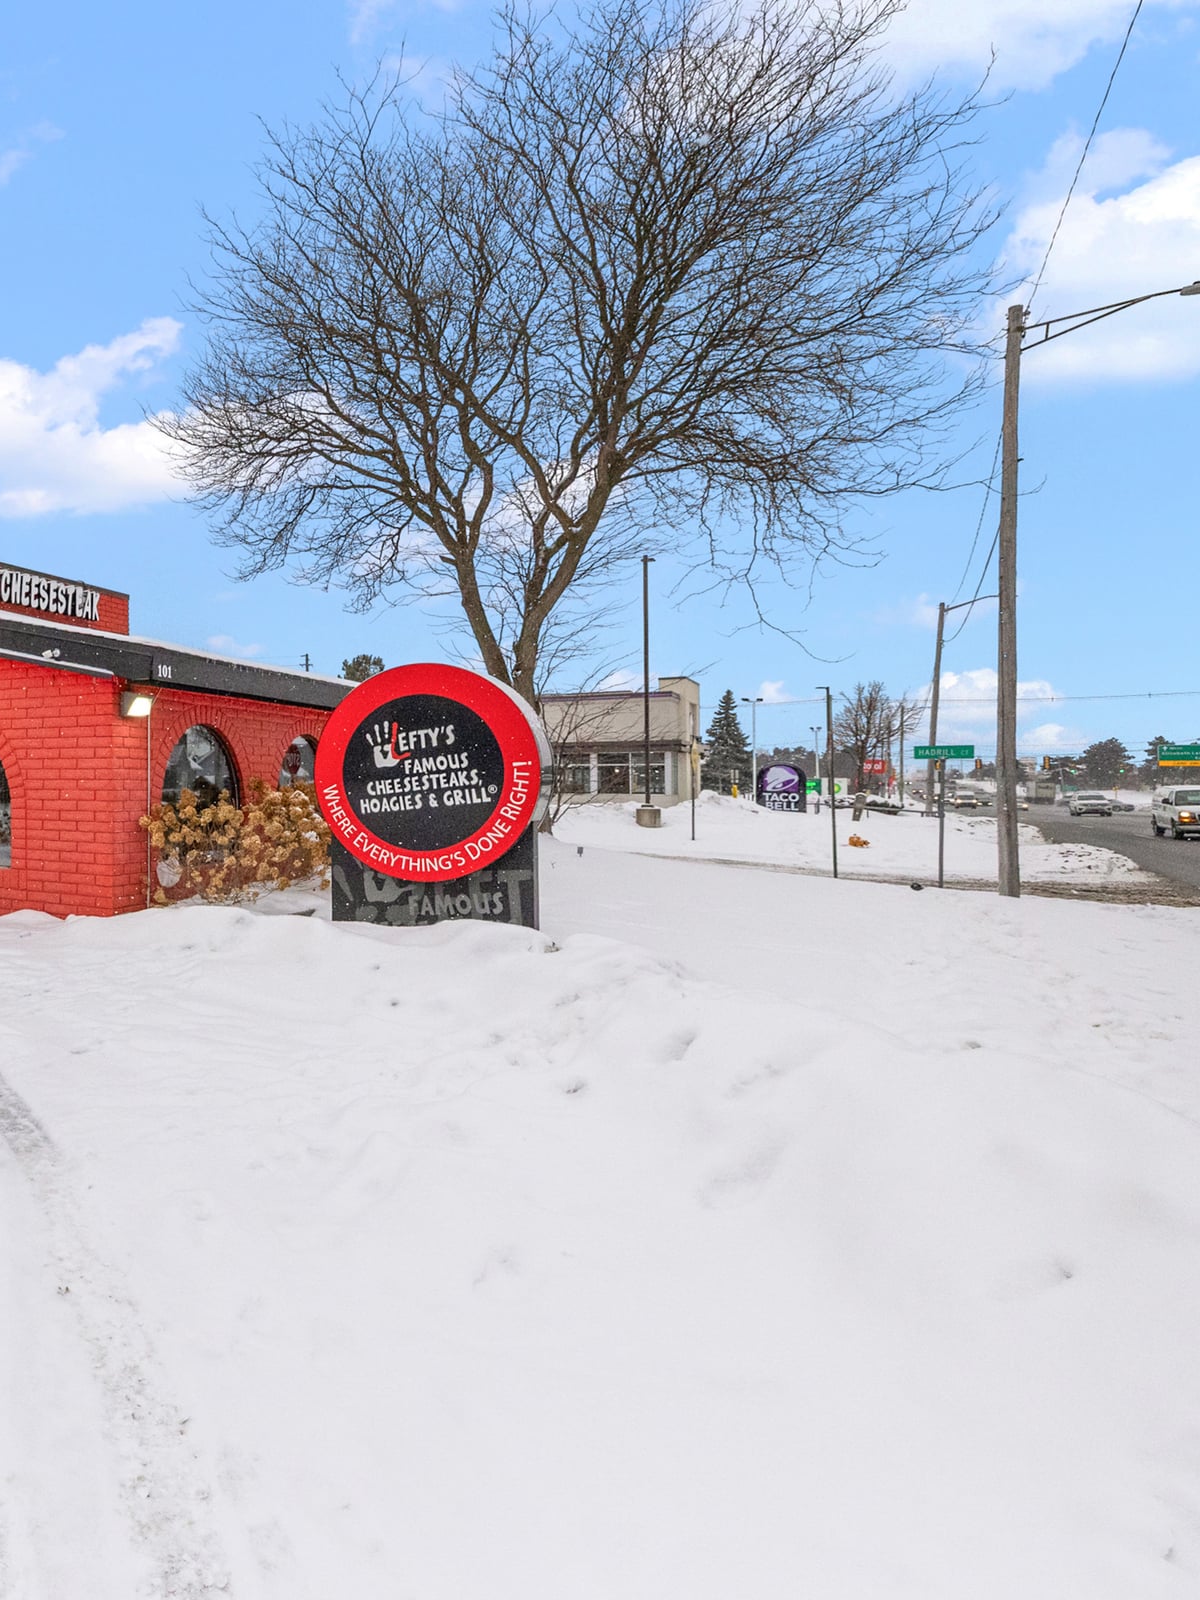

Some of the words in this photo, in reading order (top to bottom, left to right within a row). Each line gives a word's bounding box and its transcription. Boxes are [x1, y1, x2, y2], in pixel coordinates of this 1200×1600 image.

[0, 570, 101, 622] CHEESESTEAK
[157, 664, 172, 679] 101
[391, 722, 456, 760] LEFTY'S
[918, 748, 956, 756] HADRILL
[404, 752, 470, 775] FAMOUS
[366, 769, 483, 796] CHEESESTEAKS,
[360, 793, 423, 814] HOAGIES
[428, 793, 439, 808] &
[762, 792, 800, 802] TACO
[765, 802, 800, 811] BELL
[323, 784, 358, 839] WHERE
[353, 831, 466, 873] EVERYTHING'S
[464, 819, 513, 861] DONE
[500, 760, 533, 821] RIGHT!
[408, 891, 504, 917] FAMOUS
